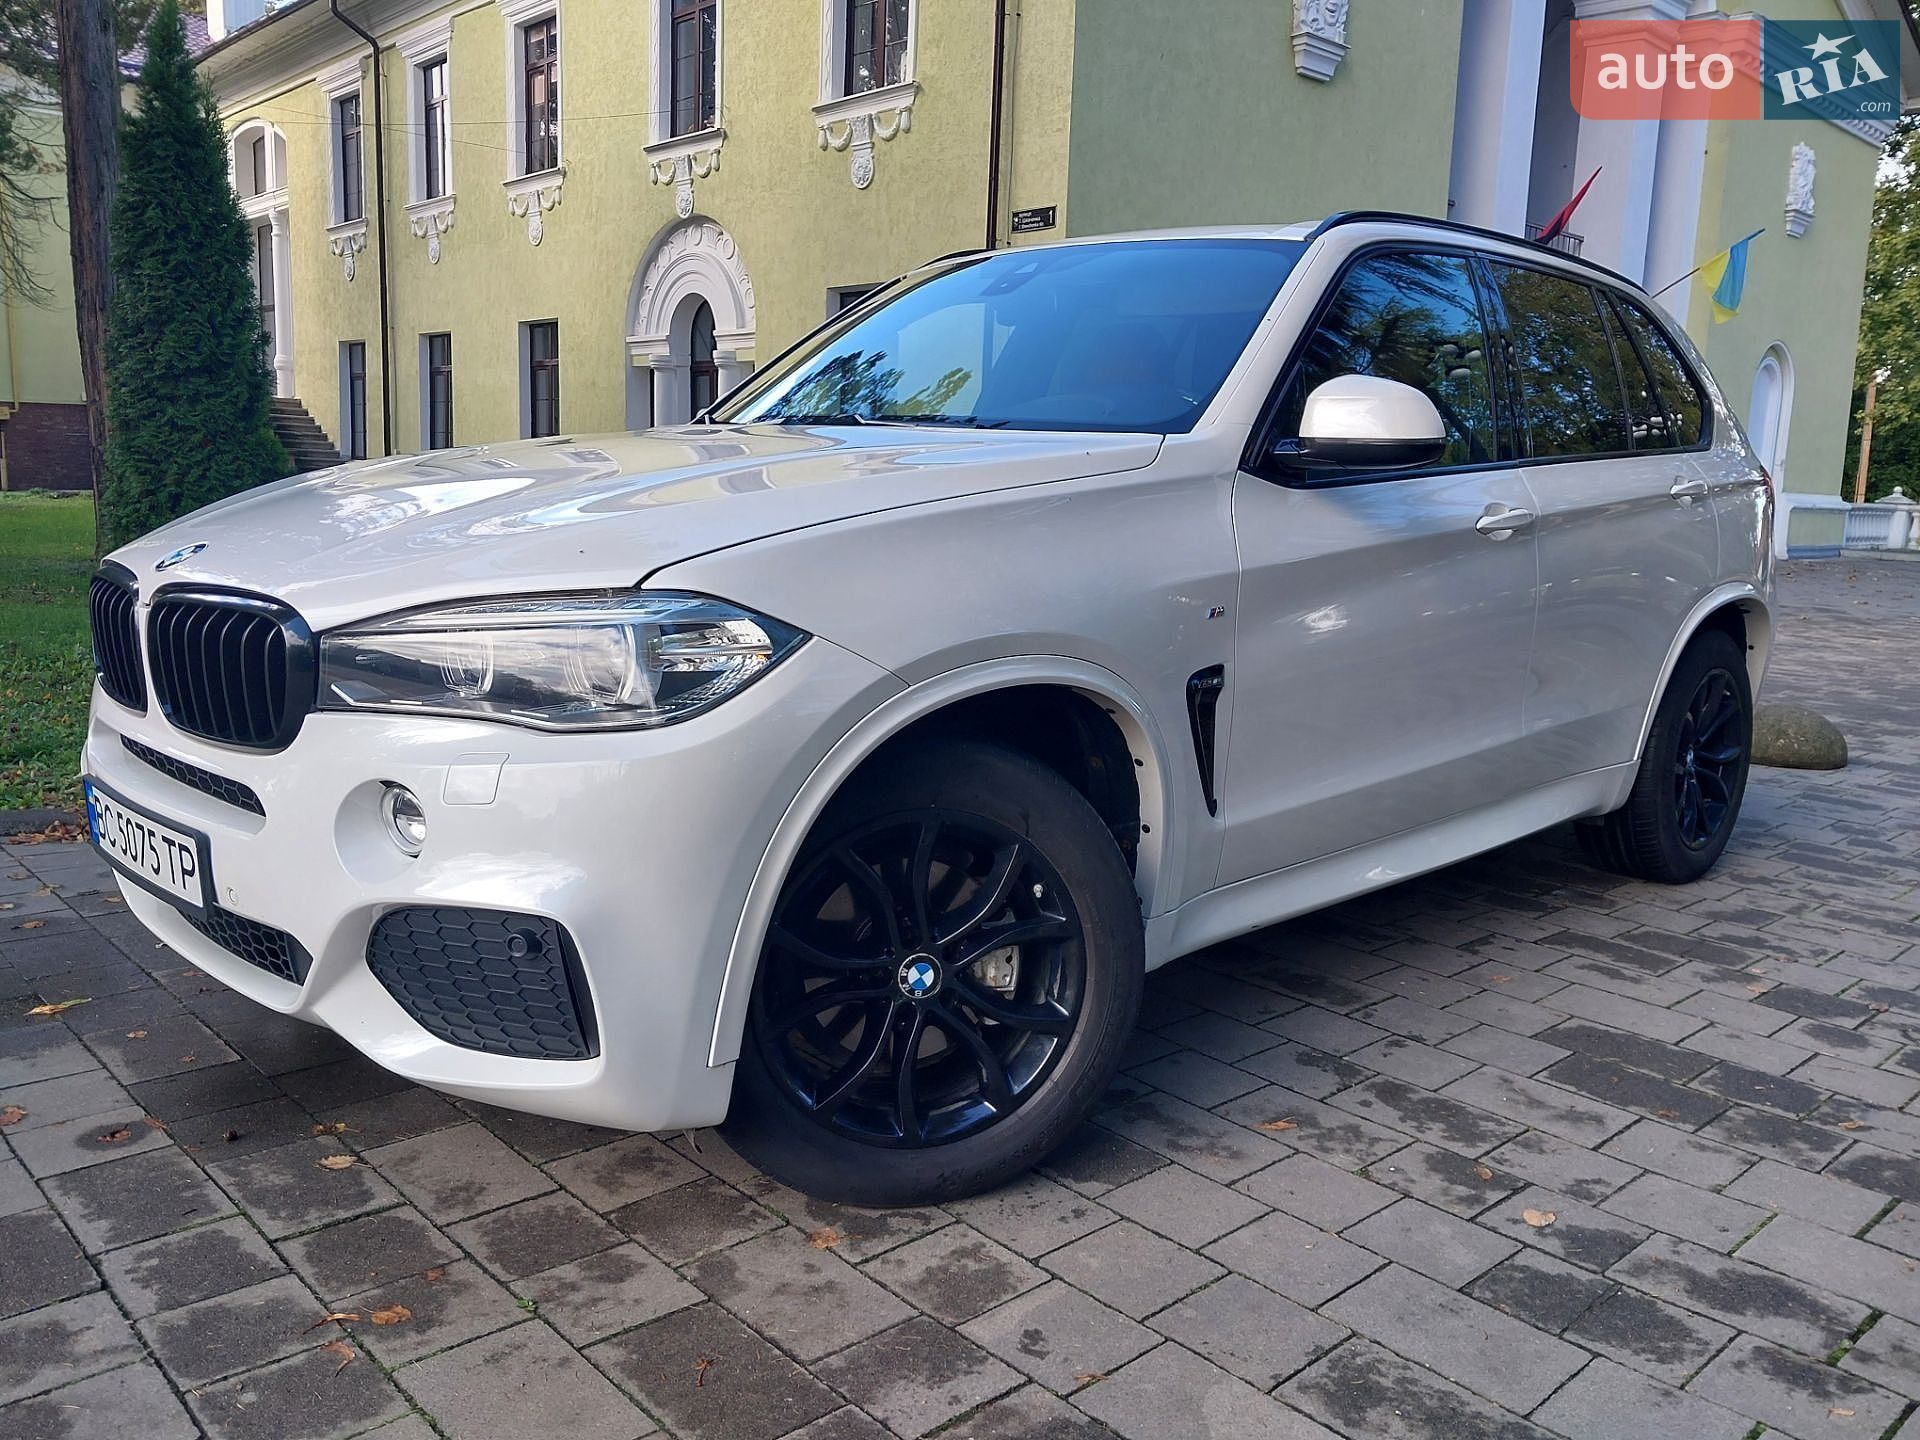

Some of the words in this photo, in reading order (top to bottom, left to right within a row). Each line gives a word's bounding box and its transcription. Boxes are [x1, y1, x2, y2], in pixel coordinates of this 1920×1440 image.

[1048, 210, 1053, 224] 1
[94, 794, 116, 848] BC
[117, 811, 160, 875] 5075
[161, 834, 195, 890] TP
